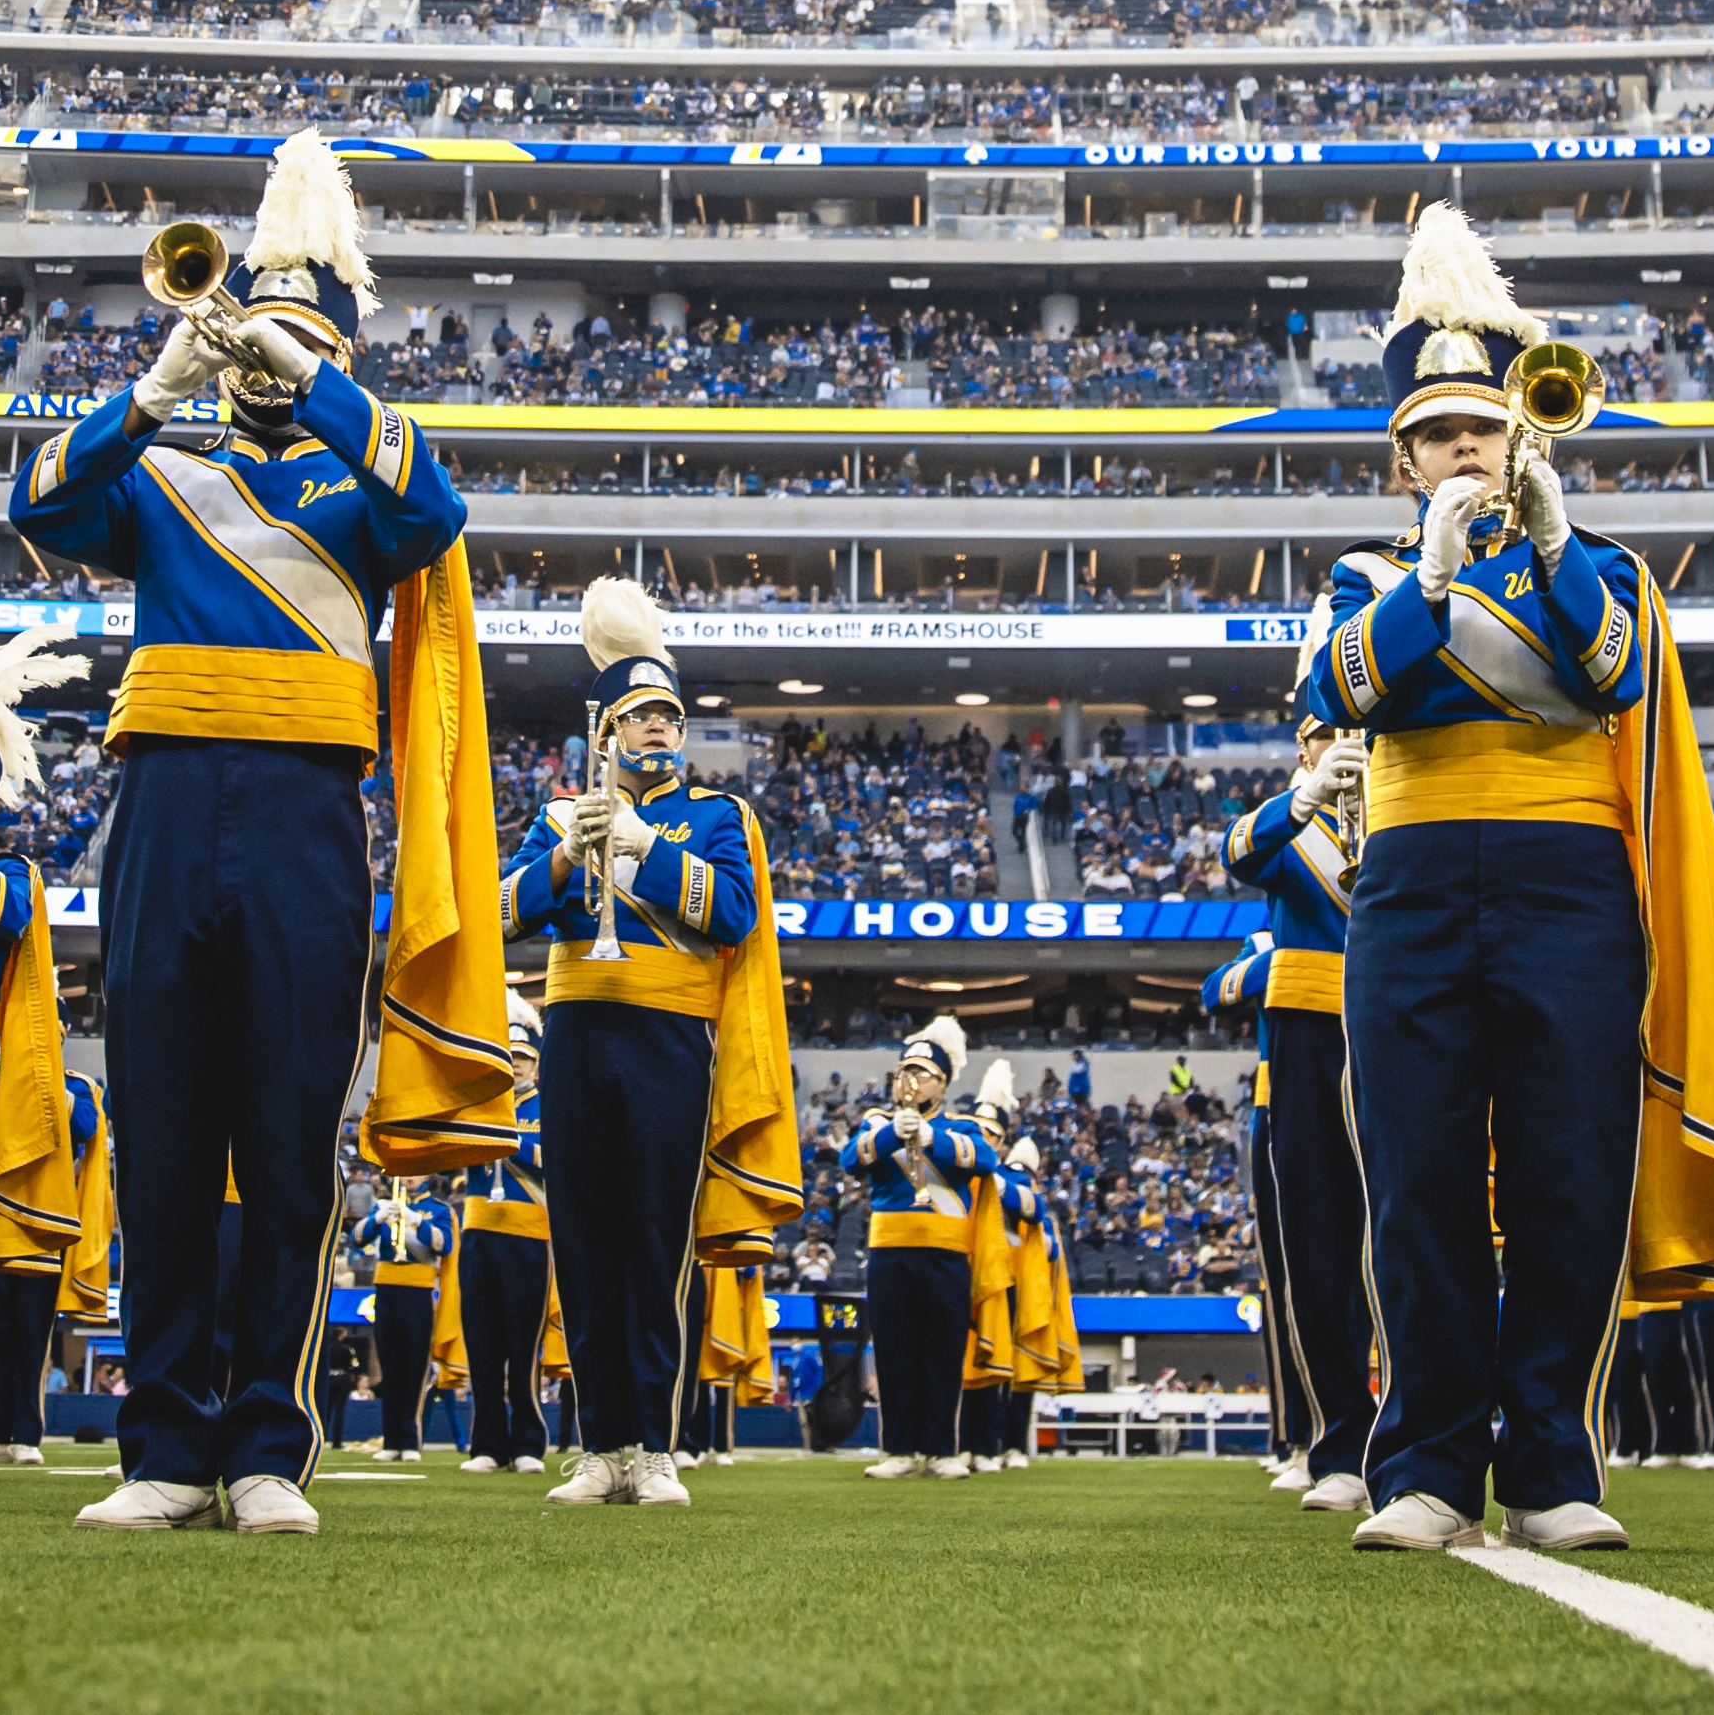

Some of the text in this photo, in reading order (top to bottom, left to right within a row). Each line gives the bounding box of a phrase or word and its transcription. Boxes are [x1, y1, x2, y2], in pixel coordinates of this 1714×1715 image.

[1084, 143, 1322, 164] OUR HOUSE
[1531, 139, 1636, 159] YOUR
[486, 619, 538, 639] sick,
[694, 621, 722, 638] for
[734, 621, 767, 638] the
[777, 621, 862, 638] ticket!!!
[870, 621, 1044, 639] #RAMSHOUSE
[1251, 620, 1306, 641] 10:1
[1345, 613, 1368, 689] BRUINS
[689, 865, 703, 914] BRUINS
[854, 901, 1123, 937] HOUSE
